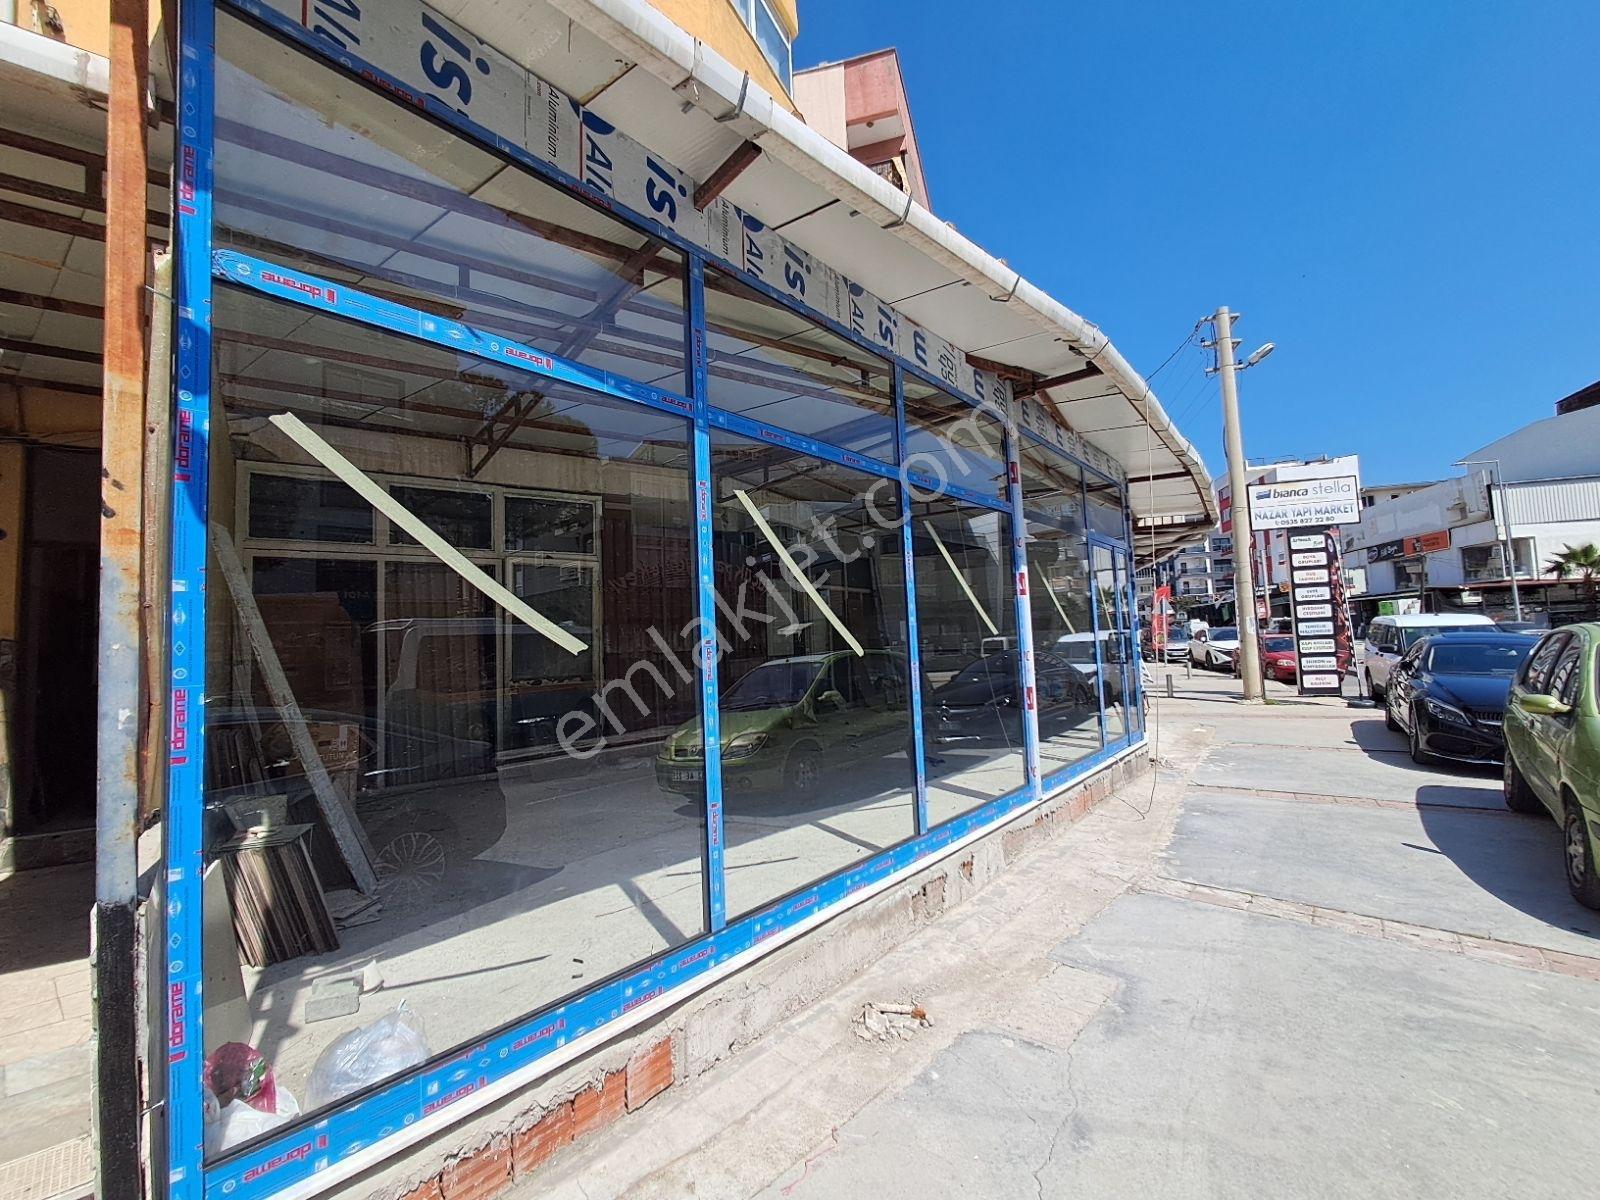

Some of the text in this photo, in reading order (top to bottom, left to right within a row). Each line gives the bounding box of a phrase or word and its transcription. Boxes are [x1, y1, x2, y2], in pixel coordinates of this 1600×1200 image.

[547, 87, 560, 158] Aluminium
[180, 144, 197, 200] dorame
[720, 199, 730, 255] Aluminium
[262, 270, 323, 300] dorame
[504, 345, 545, 369] dorame
[177, 408, 192, 469] dorame
[1273, 481, 1351, 499] bianca stella
[1291, 508, 1312, 518] YAPI
[1314, 503, 1354, 516] MARKET
[174, 688, 188, 752] dorame
[169, 981, 186, 1047] dorame
[513, 1022, 556, 1051] dorame
[423, 1081, 475, 1116] dorame
[243, 1138, 313, 1184] dorame
